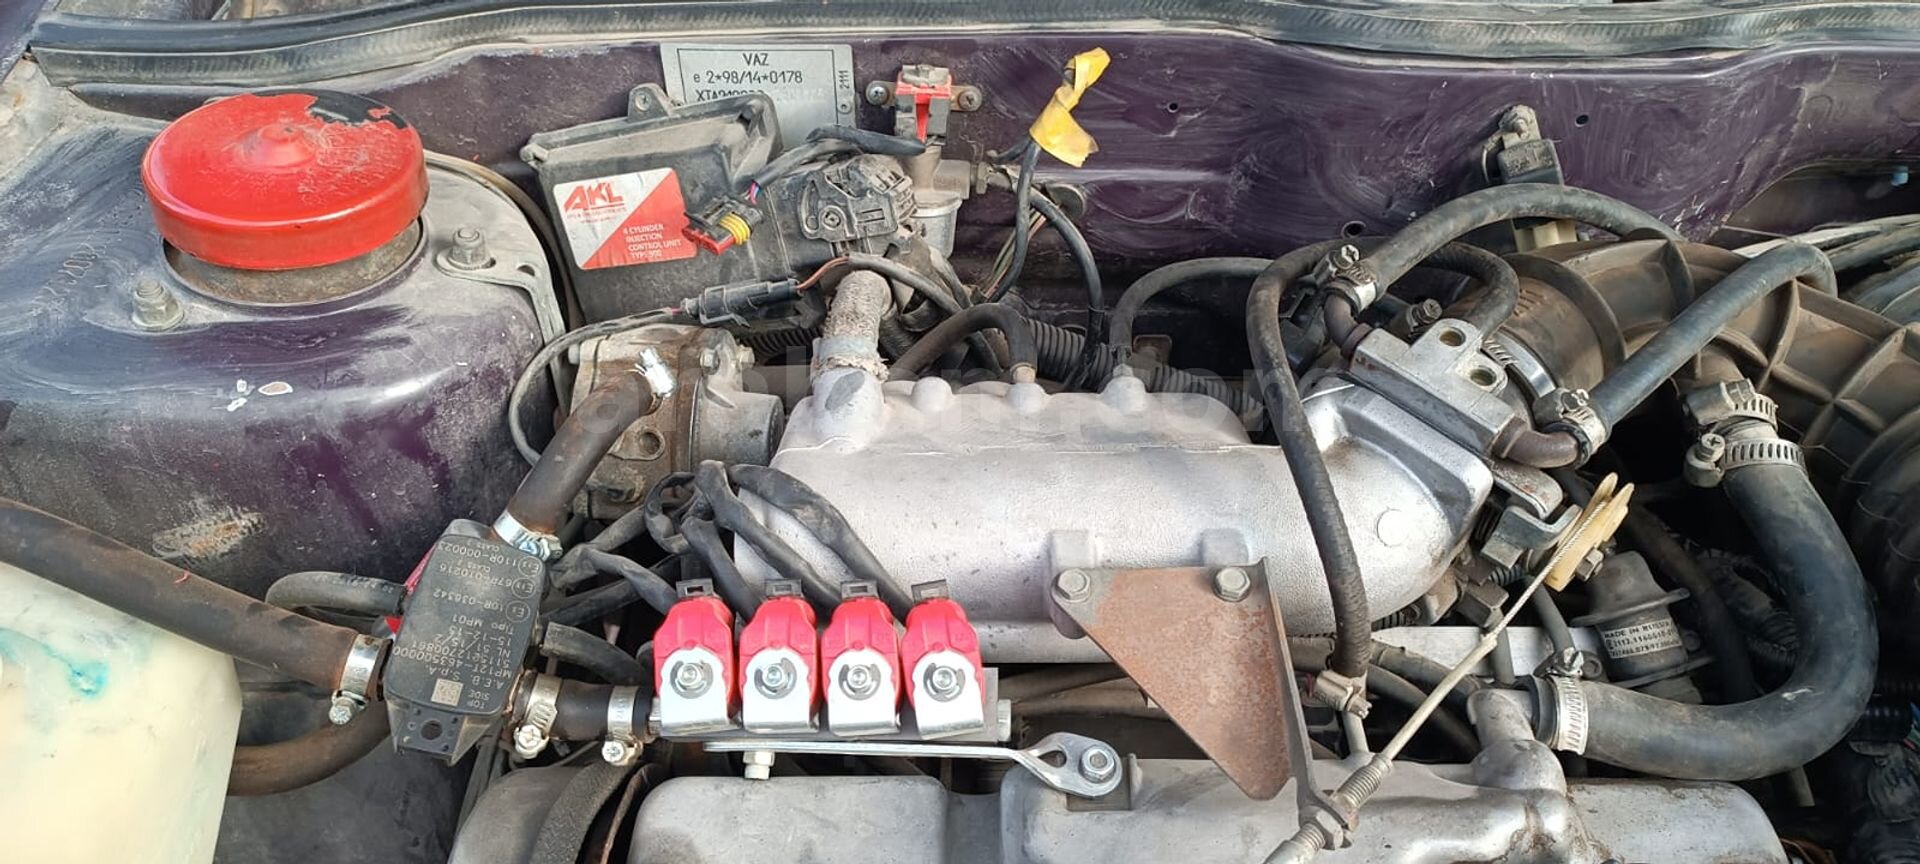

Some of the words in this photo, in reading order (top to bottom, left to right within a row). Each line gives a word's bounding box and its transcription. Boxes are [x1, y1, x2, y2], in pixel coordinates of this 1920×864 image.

[743, 52, 769, 67] VAZ
[693, 72, 701, 83] e
[838, 70, 850, 89] 2111
[563, 182, 625, 212] AKL
[629, 223, 664, 234] CYLINDER
[628, 241, 662, 252] CONTROL
[663, 239, 681, 249] UNIT
[453, 613, 483, 627] MP01
[449, 625, 511, 646] 15-12-15
[467, 689, 490, 701] SIDE
[466, 699, 485, 709] TOP
